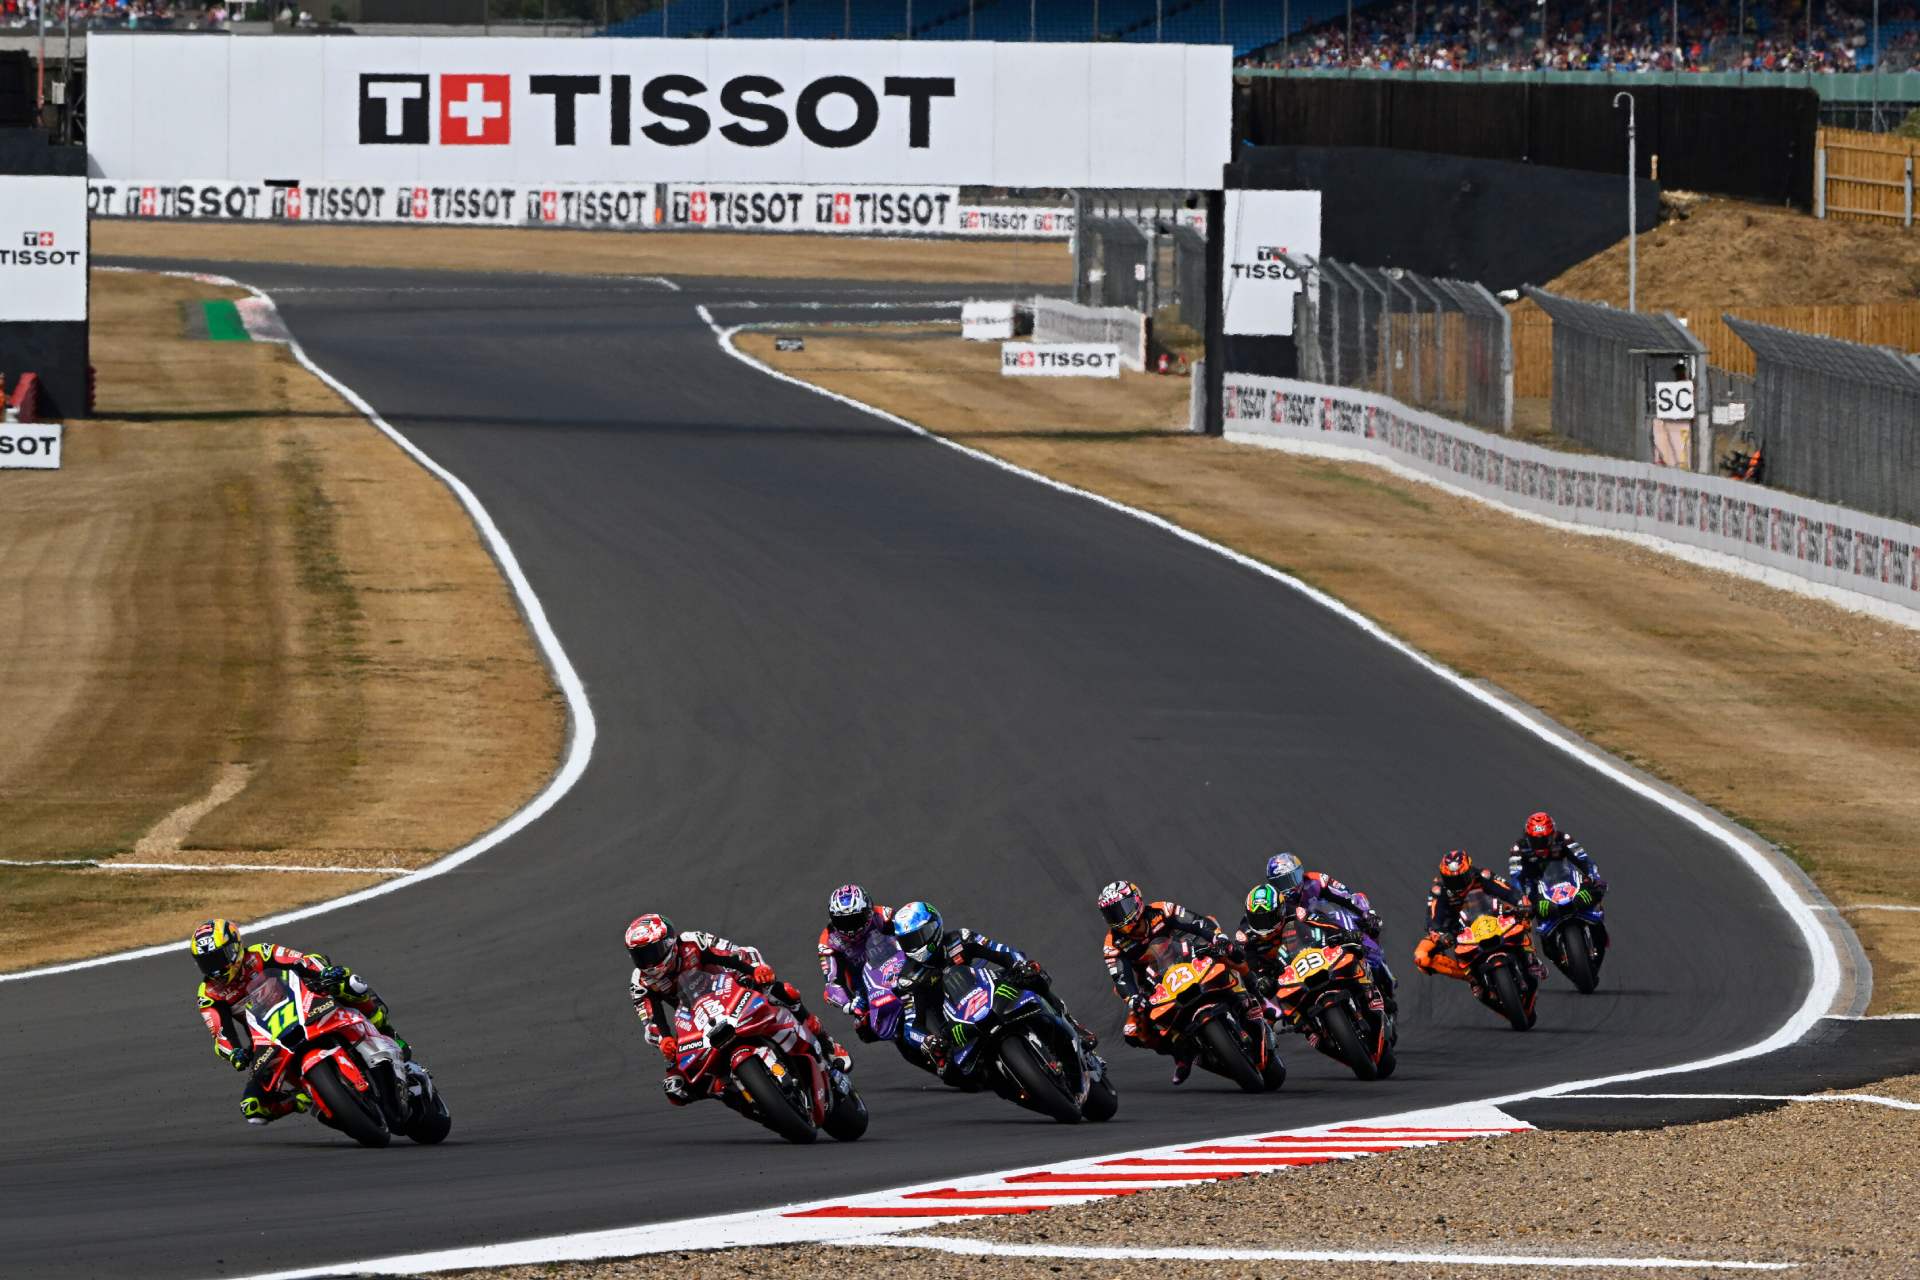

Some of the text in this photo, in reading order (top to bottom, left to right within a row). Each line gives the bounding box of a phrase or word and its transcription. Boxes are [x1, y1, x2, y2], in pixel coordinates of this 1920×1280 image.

[529, 74, 956, 148] TISSOT
[161, 185, 260, 217] TISSOT
[306, 187, 385, 219] TISSOT
[432, 188, 516, 219] TISSOT
[562, 190, 646, 223] TISSOT
[710, 192, 803, 224] TISSOT
[856, 193, 951, 225] TISSOT
[0, 250, 80, 265] TISSOT
[1038, 352, 1116, 368] TISSOT
[1658, 388, 1692, 412] SC
[1294, 952, 1325, 978] 33
[1165, 966, 1194, 992] 23
[731, 992, 751, 1018] Lenovo
[267, 1000, 299, 1042] 11
[679, 1041, 703, 1052] Lenovo
